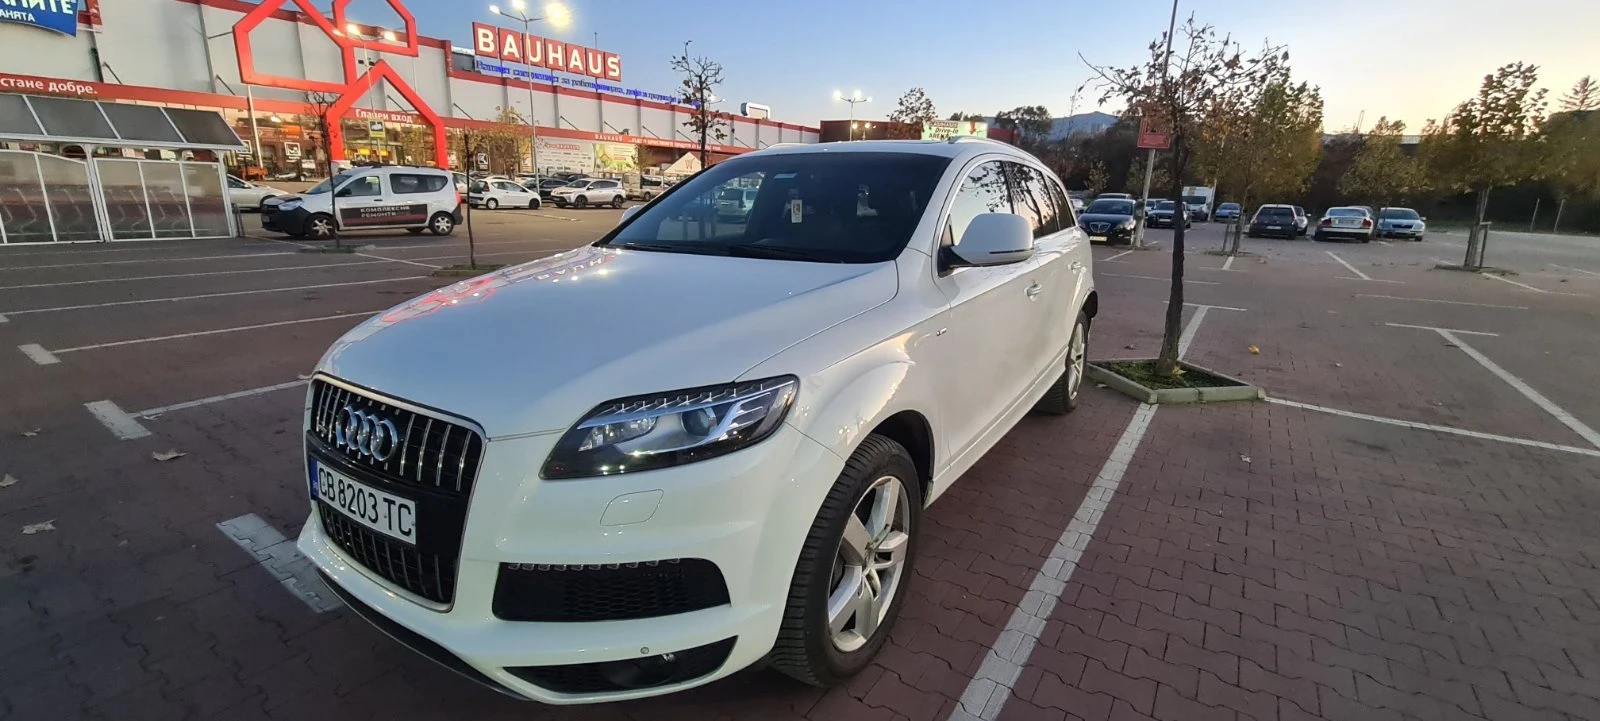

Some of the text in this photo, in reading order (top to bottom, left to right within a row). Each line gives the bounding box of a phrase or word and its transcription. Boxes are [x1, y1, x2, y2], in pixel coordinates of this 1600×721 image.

[477, 28, 620, 77] BAUHAUS
[0, 77, 98, 95] стане добре.
[391, 113, 413, 124] вход
[318, 468, 412, 536] CB 8203 TC
